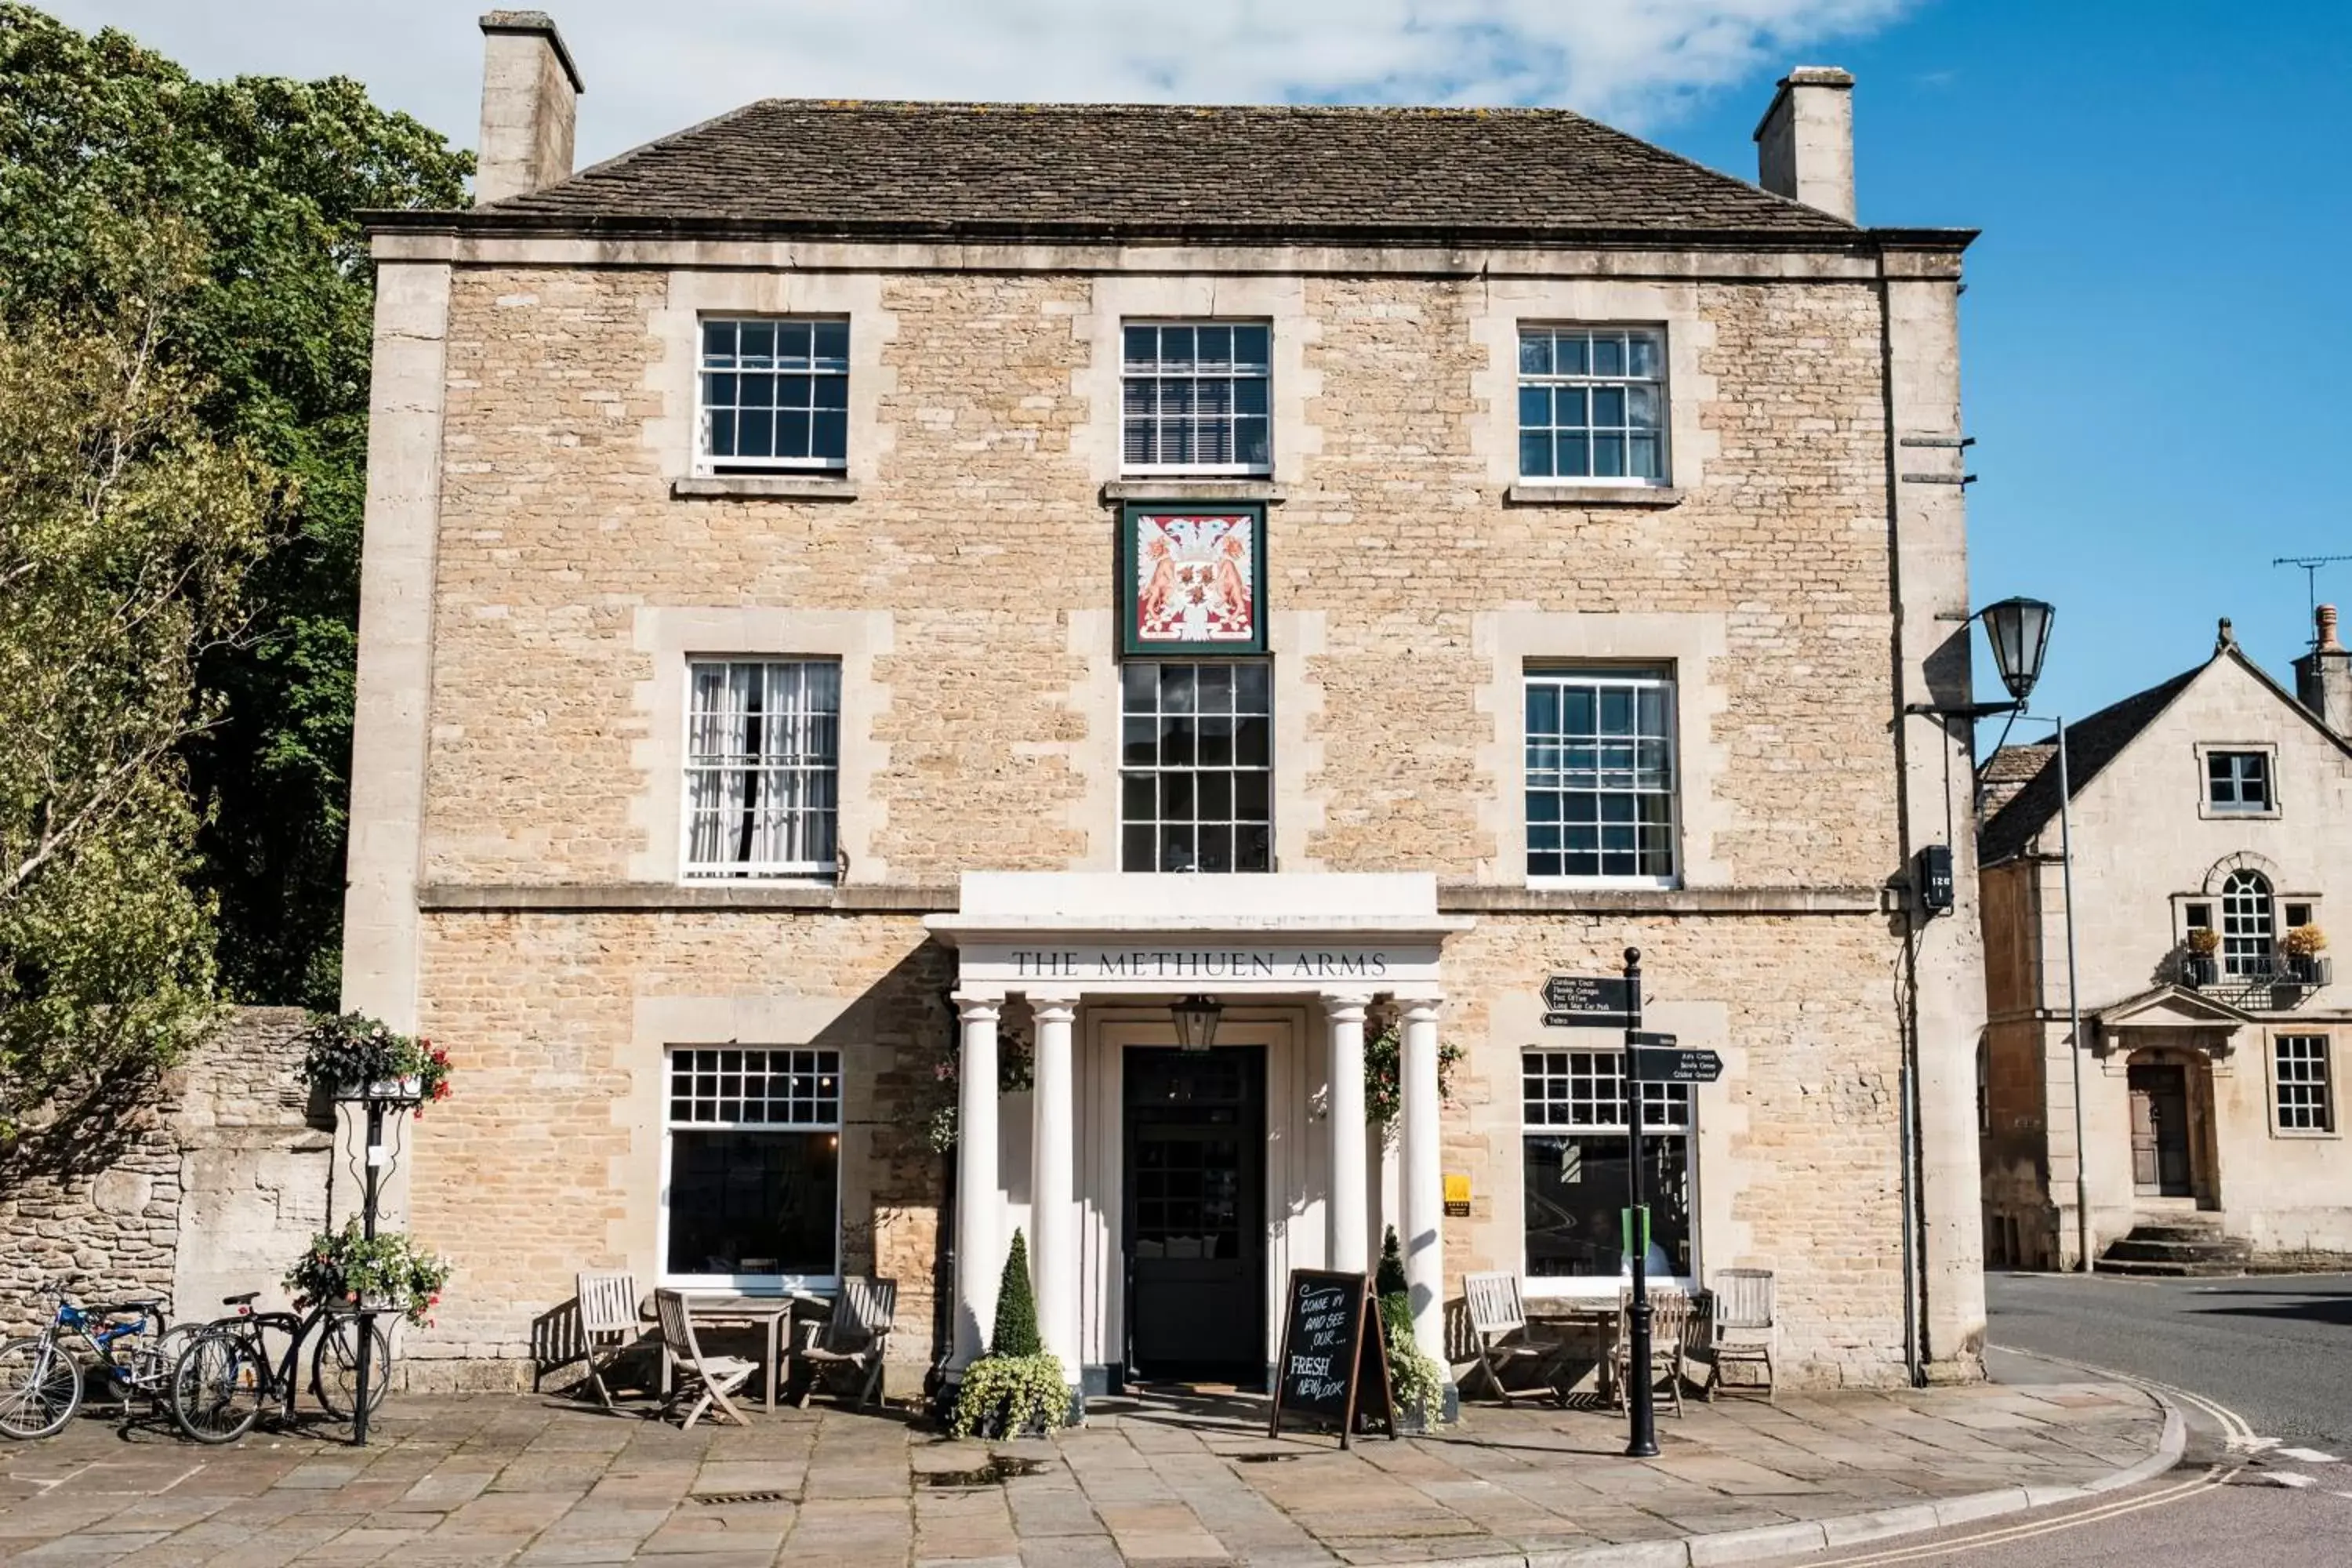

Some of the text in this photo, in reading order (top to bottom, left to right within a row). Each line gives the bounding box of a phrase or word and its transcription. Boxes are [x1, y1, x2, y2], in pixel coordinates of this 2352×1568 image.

[1012, 952, 1385, 976] THE METHUEN ARMS
[1301, 1294, 1345, 1314] COME IN
[1305, 1312, 1346, 1331] AND SEE
[1290, 1356, 1330, 1376] FRESH
[1296, 1377, 1346, 1401] NEW LOOK
